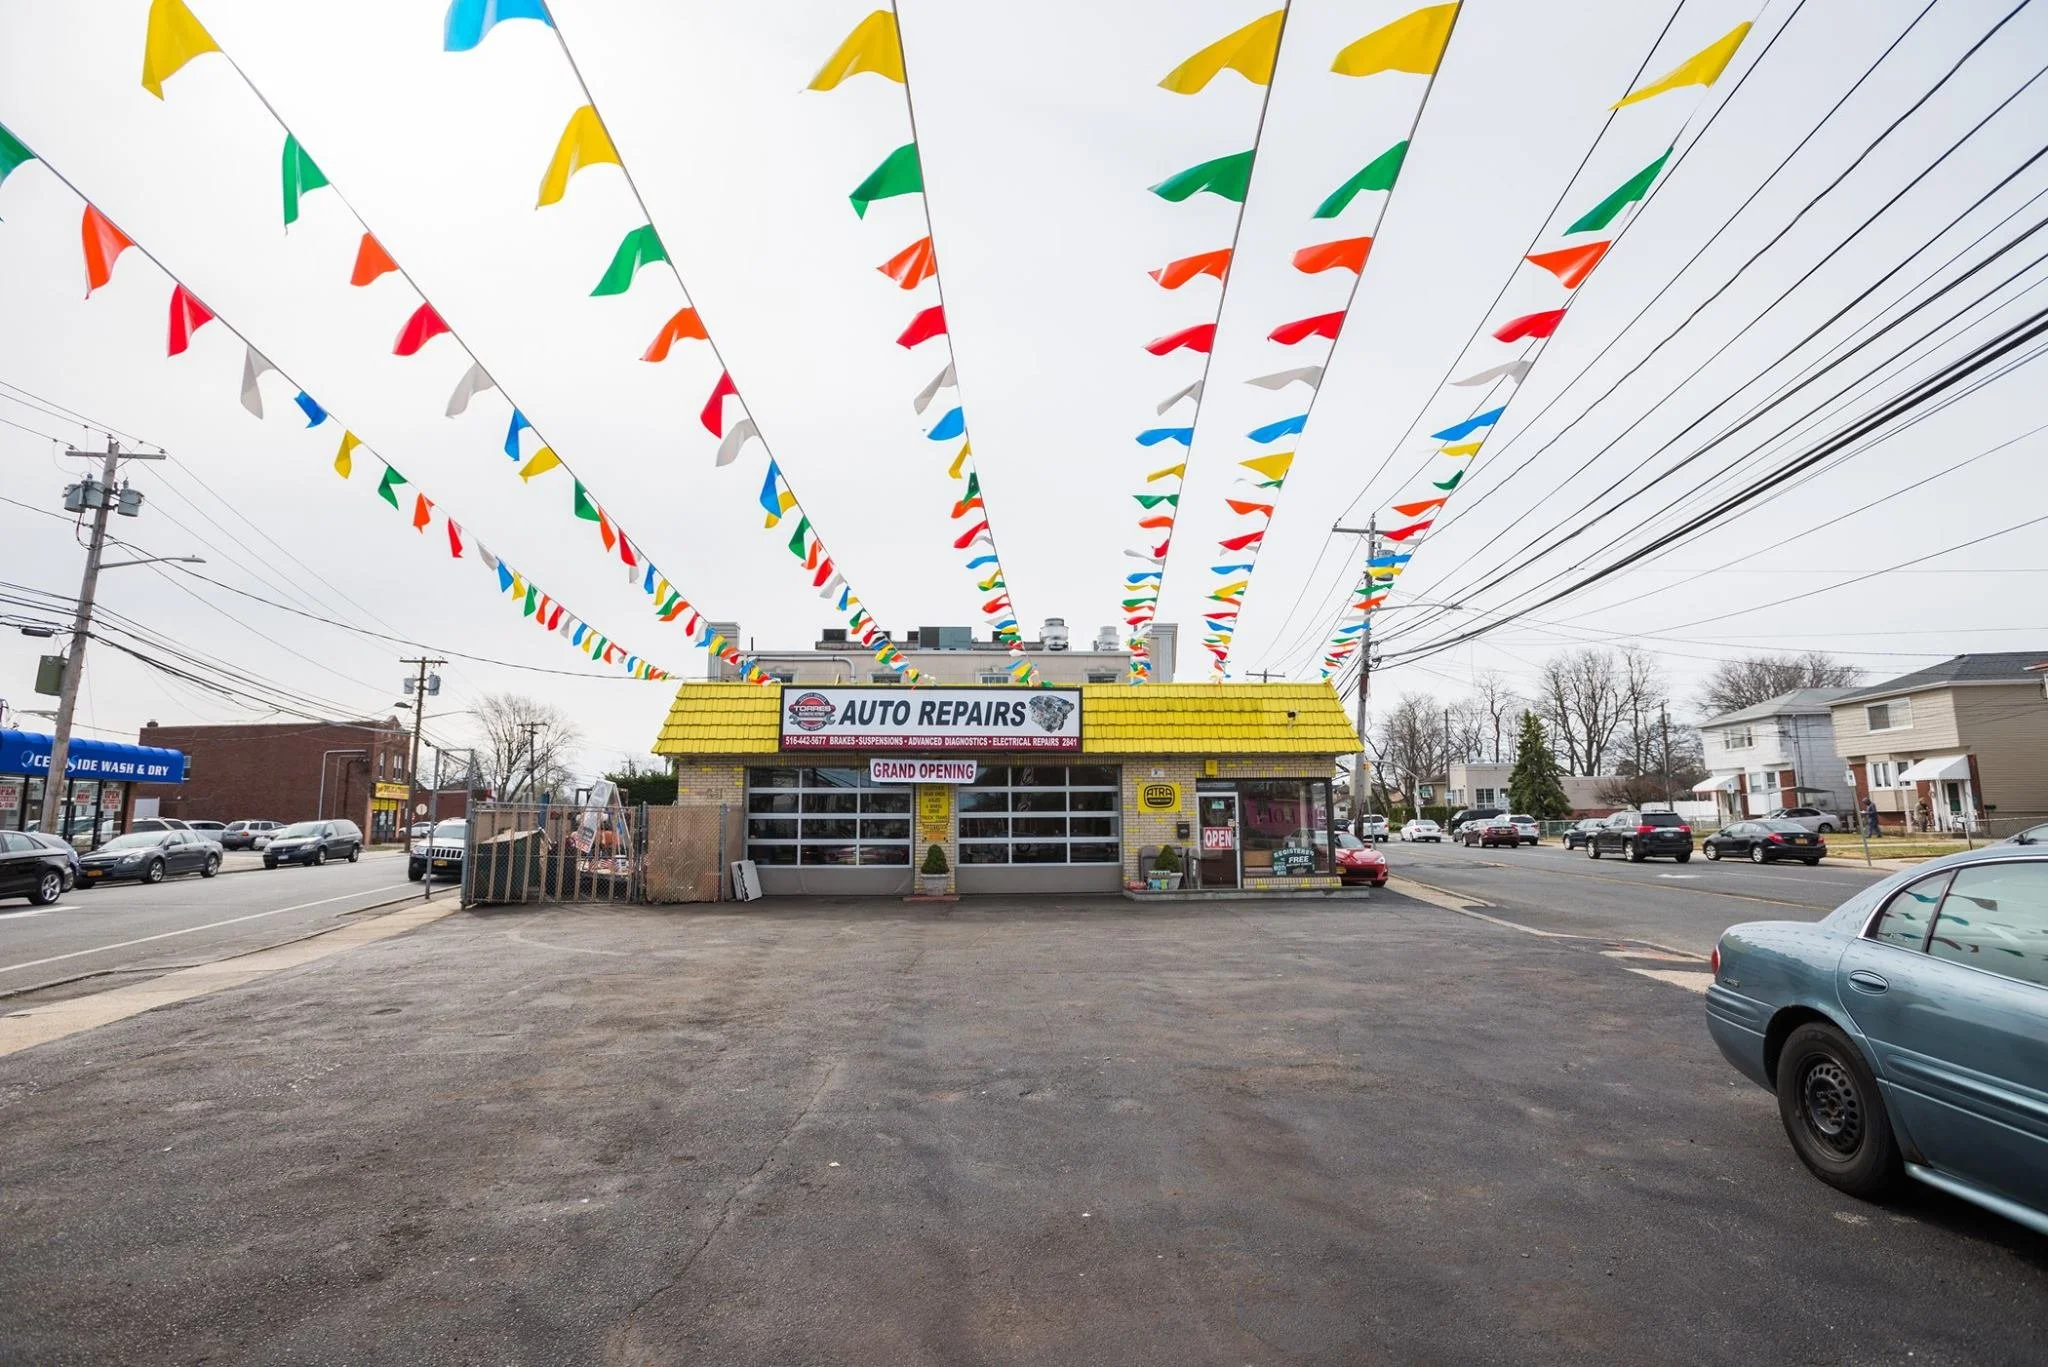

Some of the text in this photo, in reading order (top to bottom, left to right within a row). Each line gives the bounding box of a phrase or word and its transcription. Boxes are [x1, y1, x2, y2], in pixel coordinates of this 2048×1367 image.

[839, 700, 1026, 726] AUTO REPAIRS
[829, 736, 855, 745] BRAKES
[858, 736, 903, 746] SUSPENSIONS
[908, 736, 943, 746] ADVANCED
[944, 737, 988, 746] DIAGNOSTICS
[992, 737, 1032, 746] ELECTRICAL
[1032, 738, 1060, 747] REPAIRS
[101, 761, 134, 774] WASH
[136, 764, 145, 775] &
[147, 765, 169, 776] DRY
[873, 762, 974, 780] GRAND OPENING
[1146, 787, 1173, 797] ATRA
[1205, 829, 1232, 847] OPEN
[1273, 848, 1315, 858] REGISTERED
[1288, 855, 1310, 864] FREE
